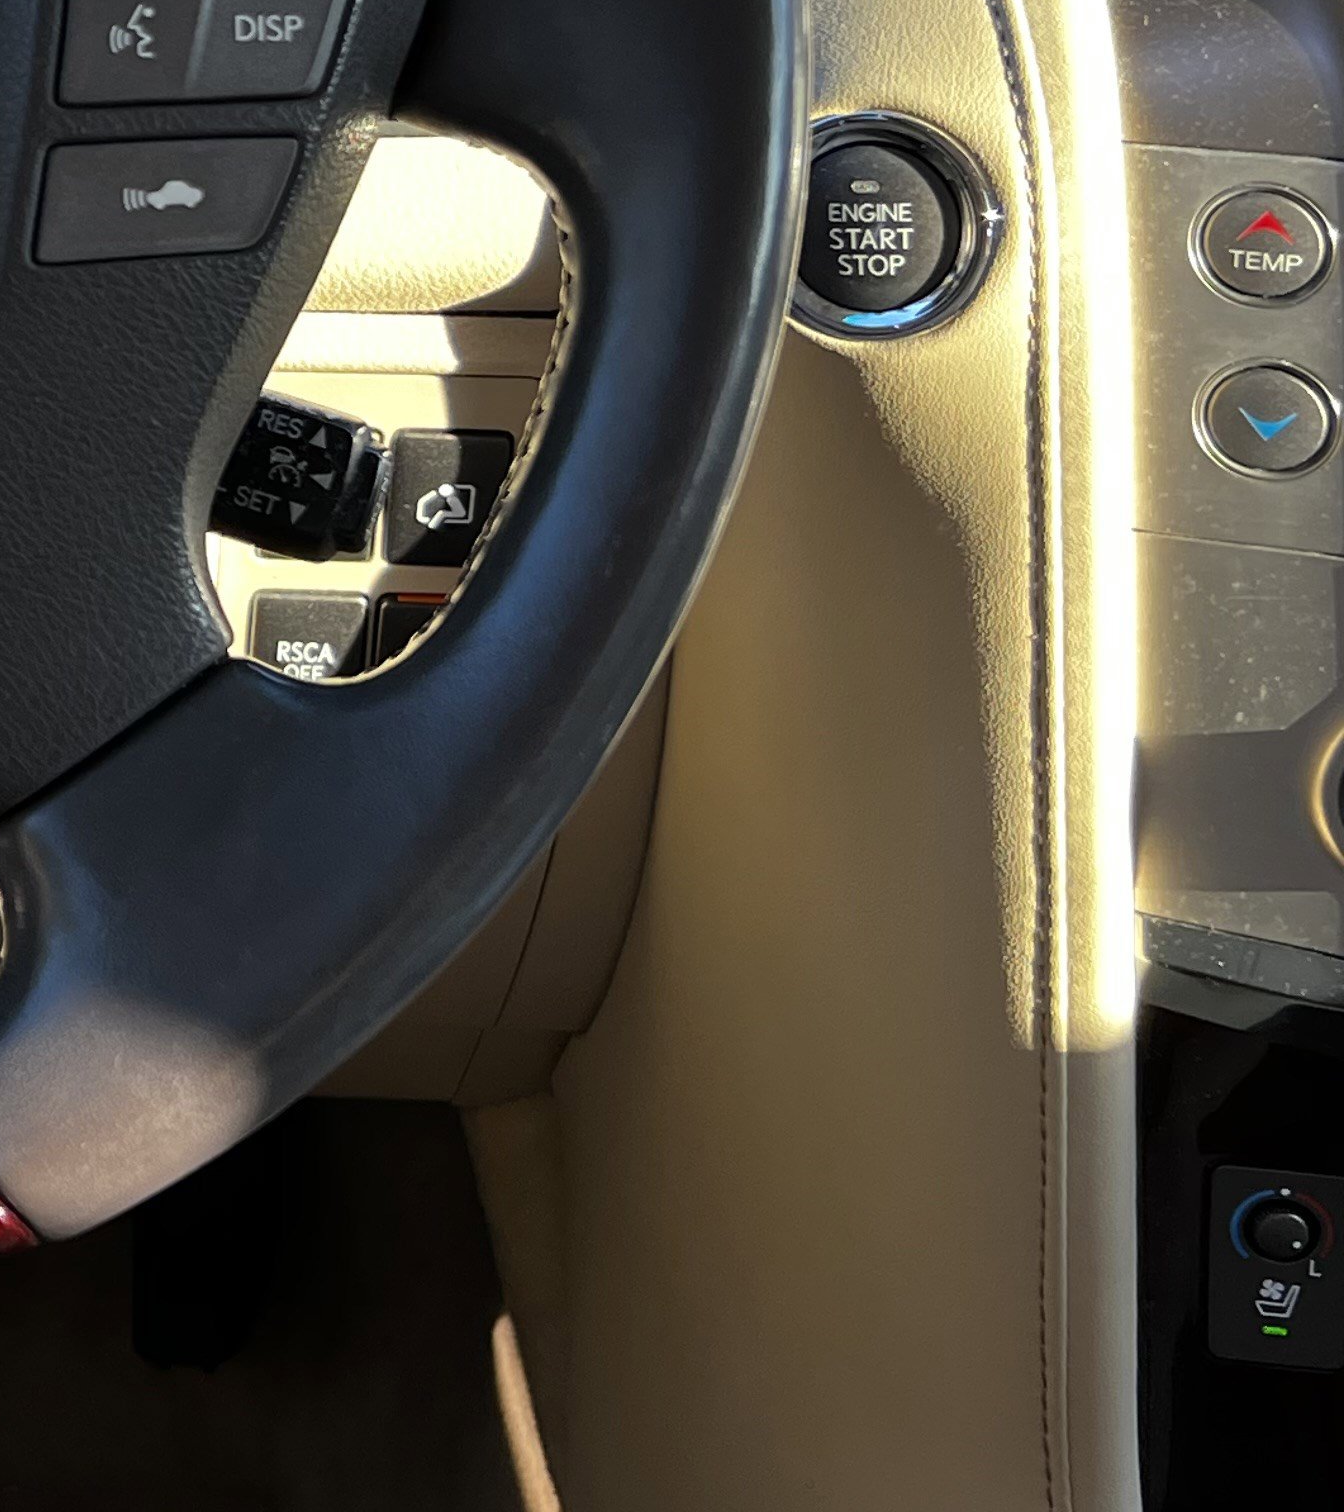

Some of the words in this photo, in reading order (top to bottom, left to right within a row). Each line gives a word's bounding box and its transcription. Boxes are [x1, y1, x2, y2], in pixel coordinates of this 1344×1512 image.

[234, 15, 305, 42] DISP
[828, 202, 913, 223] ENGINE
[829, 227, 914, 250] START
[837, 253, 906, 277] STOP
[1228, 248, 1304, 274] TEMP
[258, 408, 305, 439] RES
[233, 484, 281, 516] SET
[276, 640, 334, 663] RSCA
[1309, 1259, 1322, 1278] L
